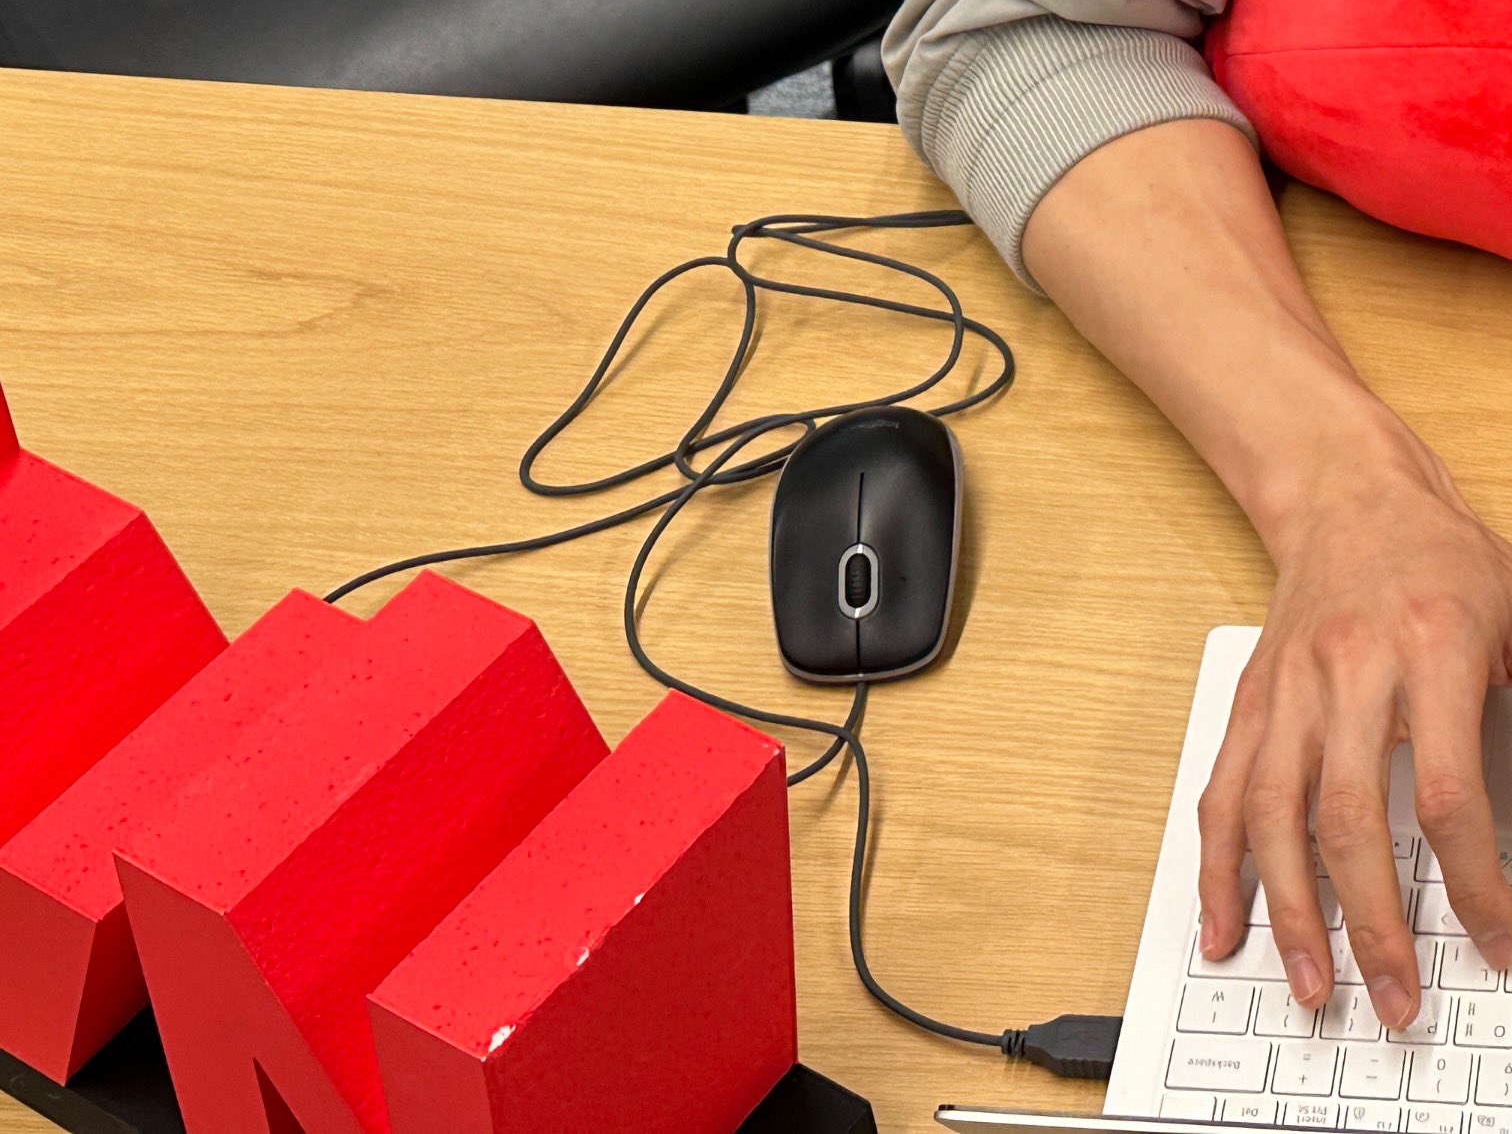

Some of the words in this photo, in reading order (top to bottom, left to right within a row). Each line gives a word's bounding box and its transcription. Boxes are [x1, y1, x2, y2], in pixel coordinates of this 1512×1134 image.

[1481, 969, 1488, 981] L
[1427, 1022, 1437, 1034] P
[1494, 1025, 1506, 1038] O
[1187, 1058, 1240, 1070] Backspace
[1437, 1059, 1446, 1071] 0
[1505, 1063, 1512, 1074] 9
[1241, 1107, 1259, 1117] Del
